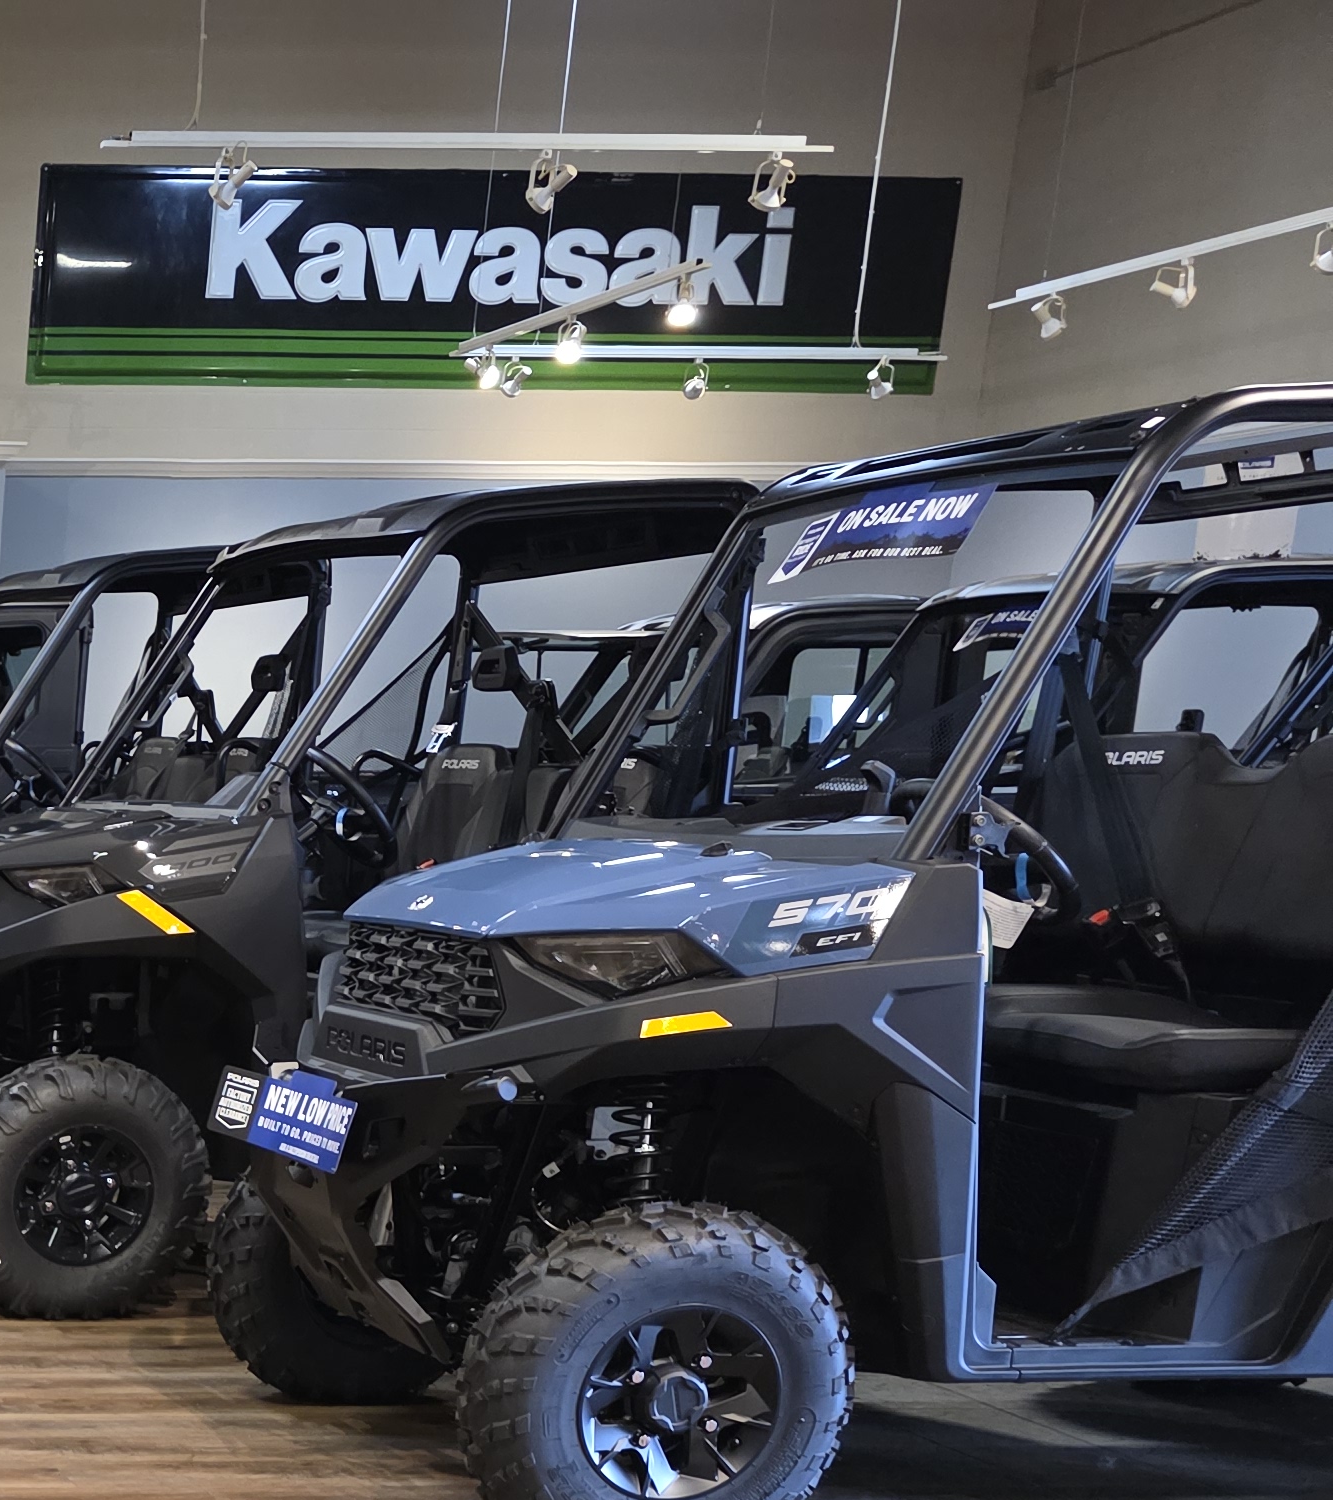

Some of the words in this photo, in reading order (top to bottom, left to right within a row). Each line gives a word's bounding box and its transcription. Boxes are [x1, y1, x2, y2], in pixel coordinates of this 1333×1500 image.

[205, 198, 795, 307] Kawasaki
[836, 507, 869, 533] ON
[863, 498, 926, 527] SALE
[917, 493, 979, 521] NOW
[852, 549, 866, 558] ASK
[867, 548, 883, 557] FOR
[442, 759, 480, 769] POLARIS
[816, 932, 862, 947] EFI
[327, 1026, 405, 1067] POLARIS
[263, 1084, 302, 1117] NEW
[297, 1094, 330, 1126] LOW
[323, 1102, 353, 1134] PRICE
[258, 1116, 282, 1132] BUILT
[280, 1123, 291, 1136] TO
